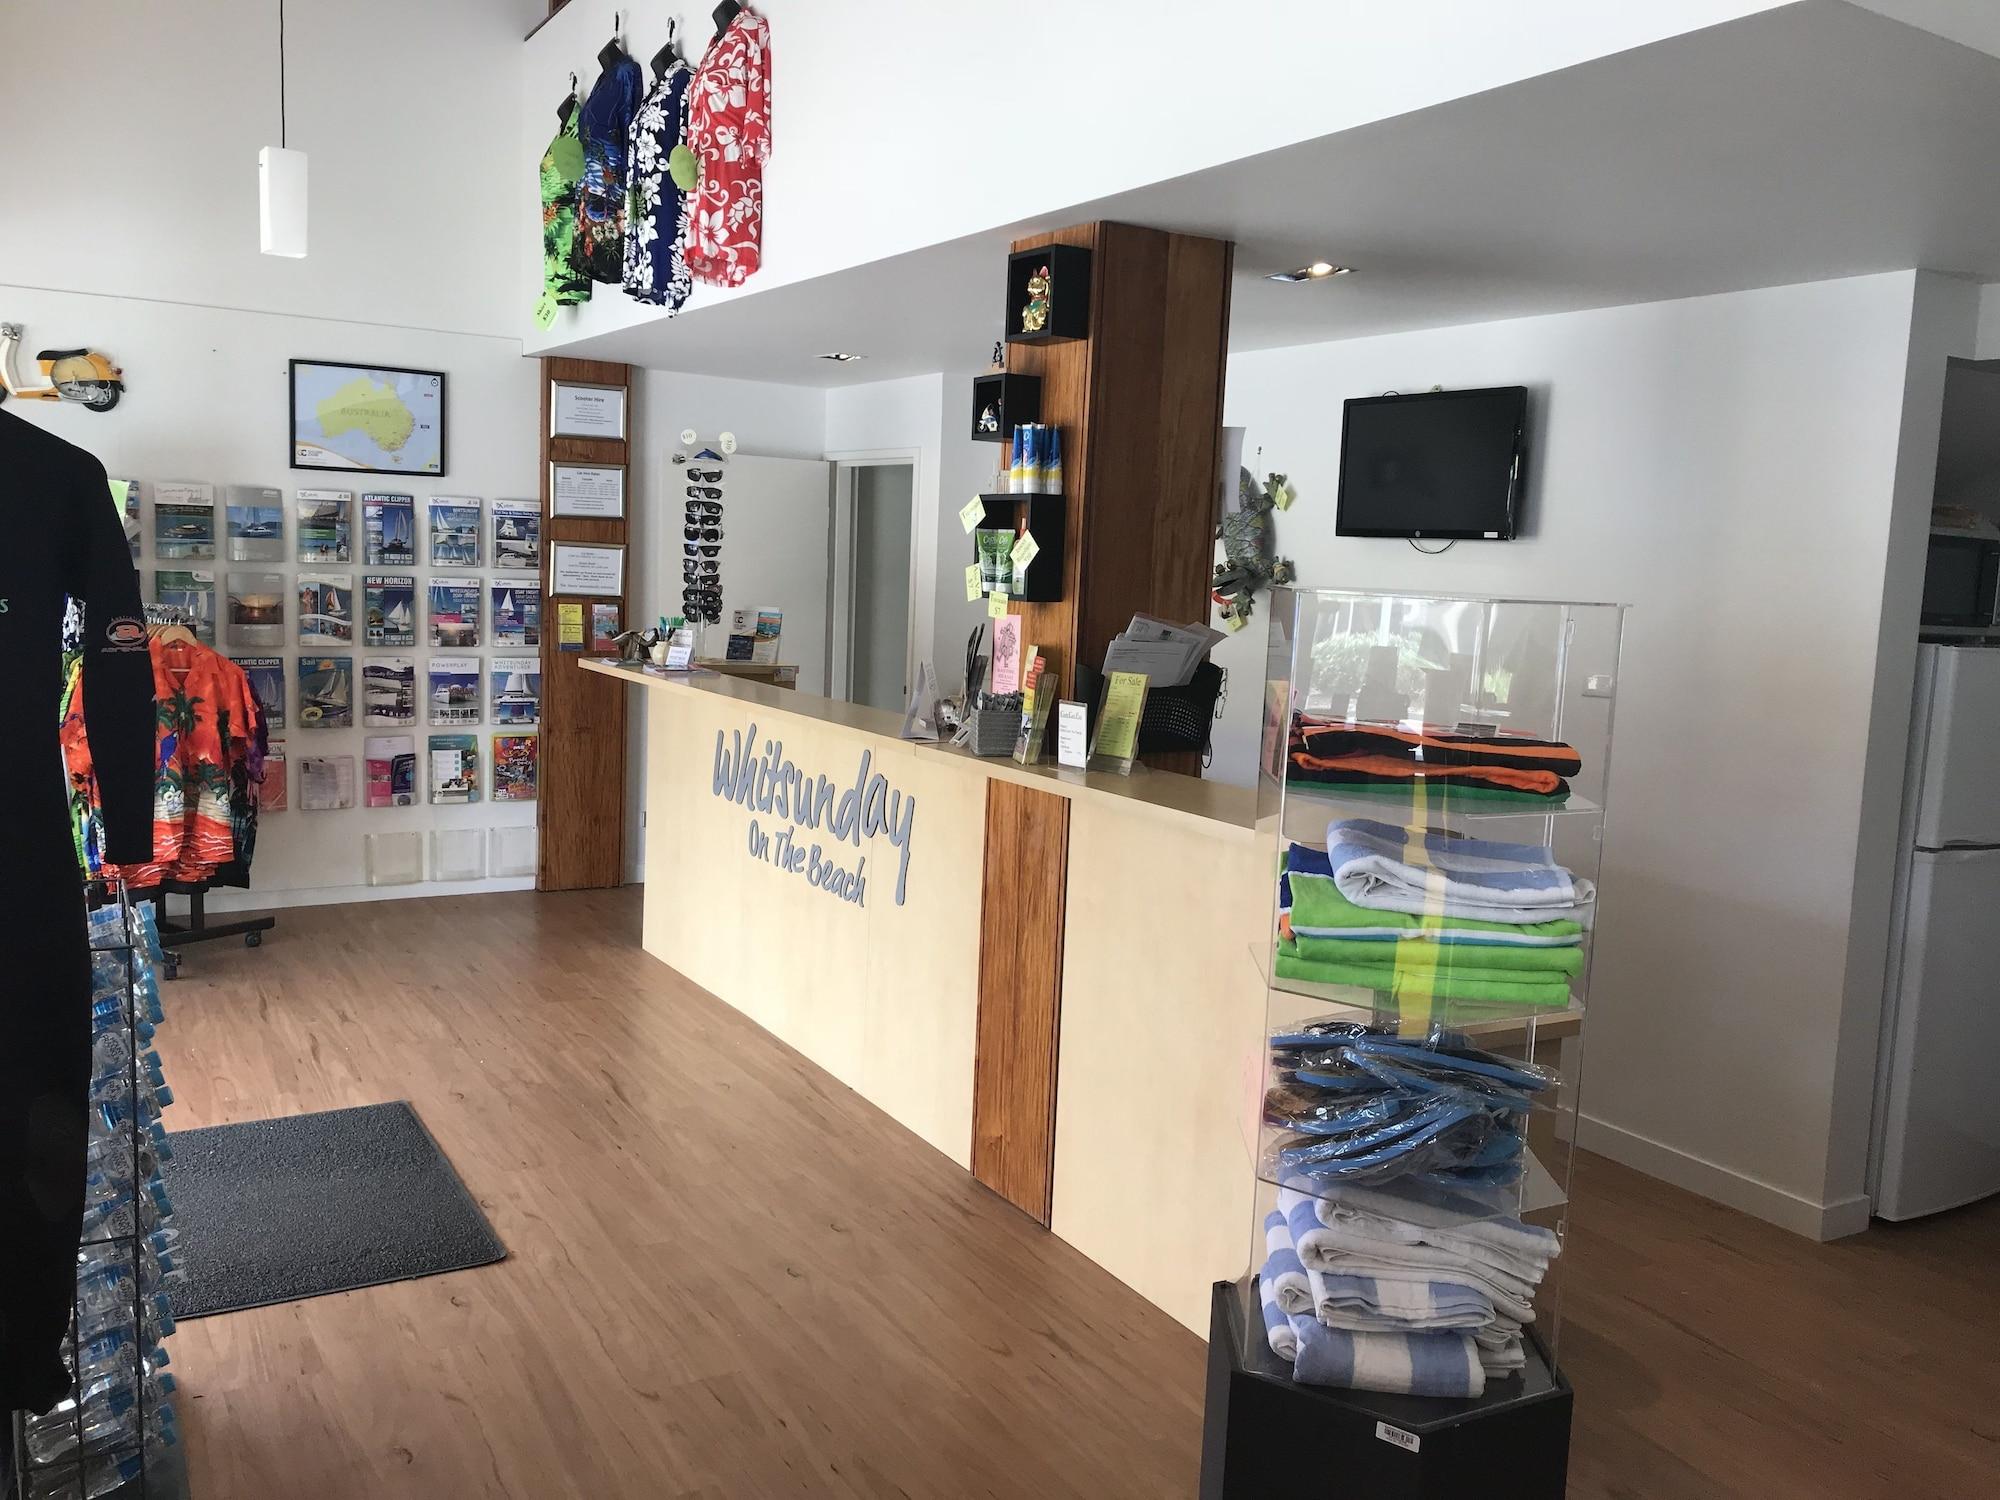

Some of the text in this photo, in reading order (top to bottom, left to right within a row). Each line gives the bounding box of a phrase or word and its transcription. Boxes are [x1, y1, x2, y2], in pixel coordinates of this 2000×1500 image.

[340, 407, 392, 418] AUSTRALIA
[364, 495, 390, 503] ATLANTIC
[366, 576, 412, 585] NEW HORIZON
[1114, 675, 1142, 686] For Sale
[713, 723, 915, 906] Whitsunday
[749, 819, 865, 907] On The Beach
